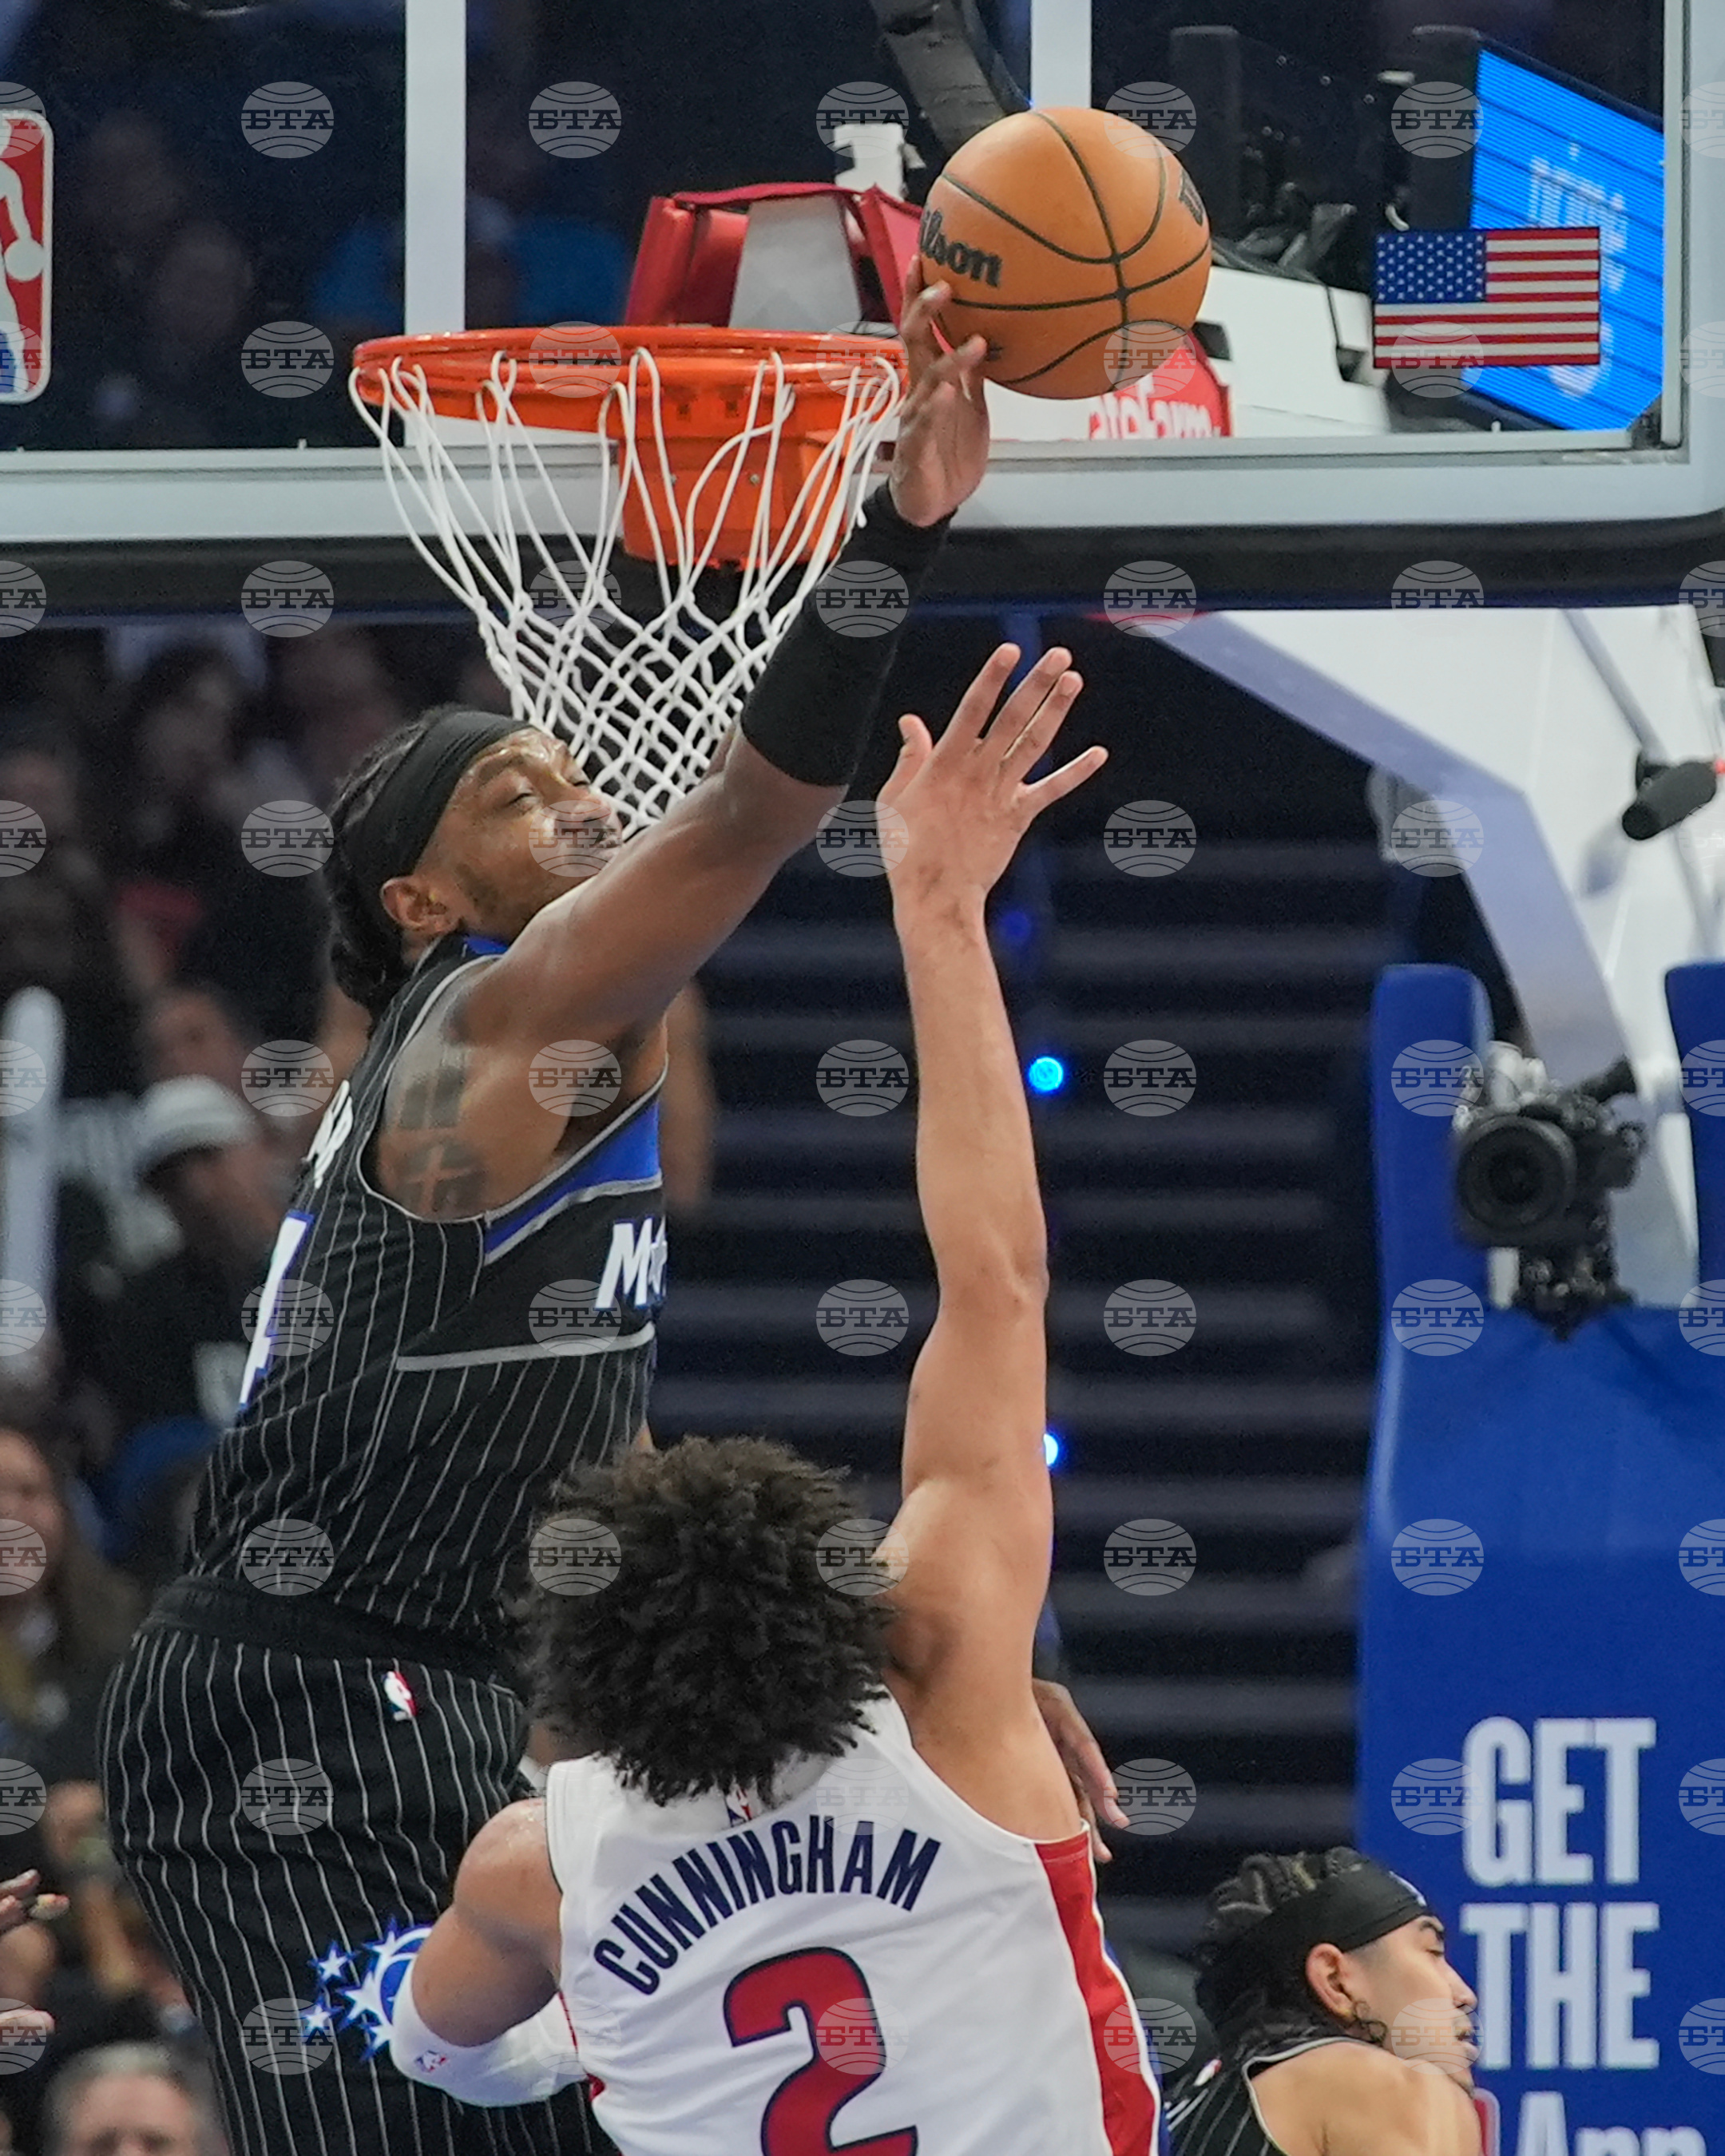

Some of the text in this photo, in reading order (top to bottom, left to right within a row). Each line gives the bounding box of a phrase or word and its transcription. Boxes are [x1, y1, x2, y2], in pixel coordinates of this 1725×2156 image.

[919, 209, 1002, 287] ilson
[1461, 1716, 1657, 1887] GET
[593, 1815, 941, 1995] CUNNINGHAM
[1459, 1901, 1660, 2070] THE
[723, 1946, 919, 2156] 2
